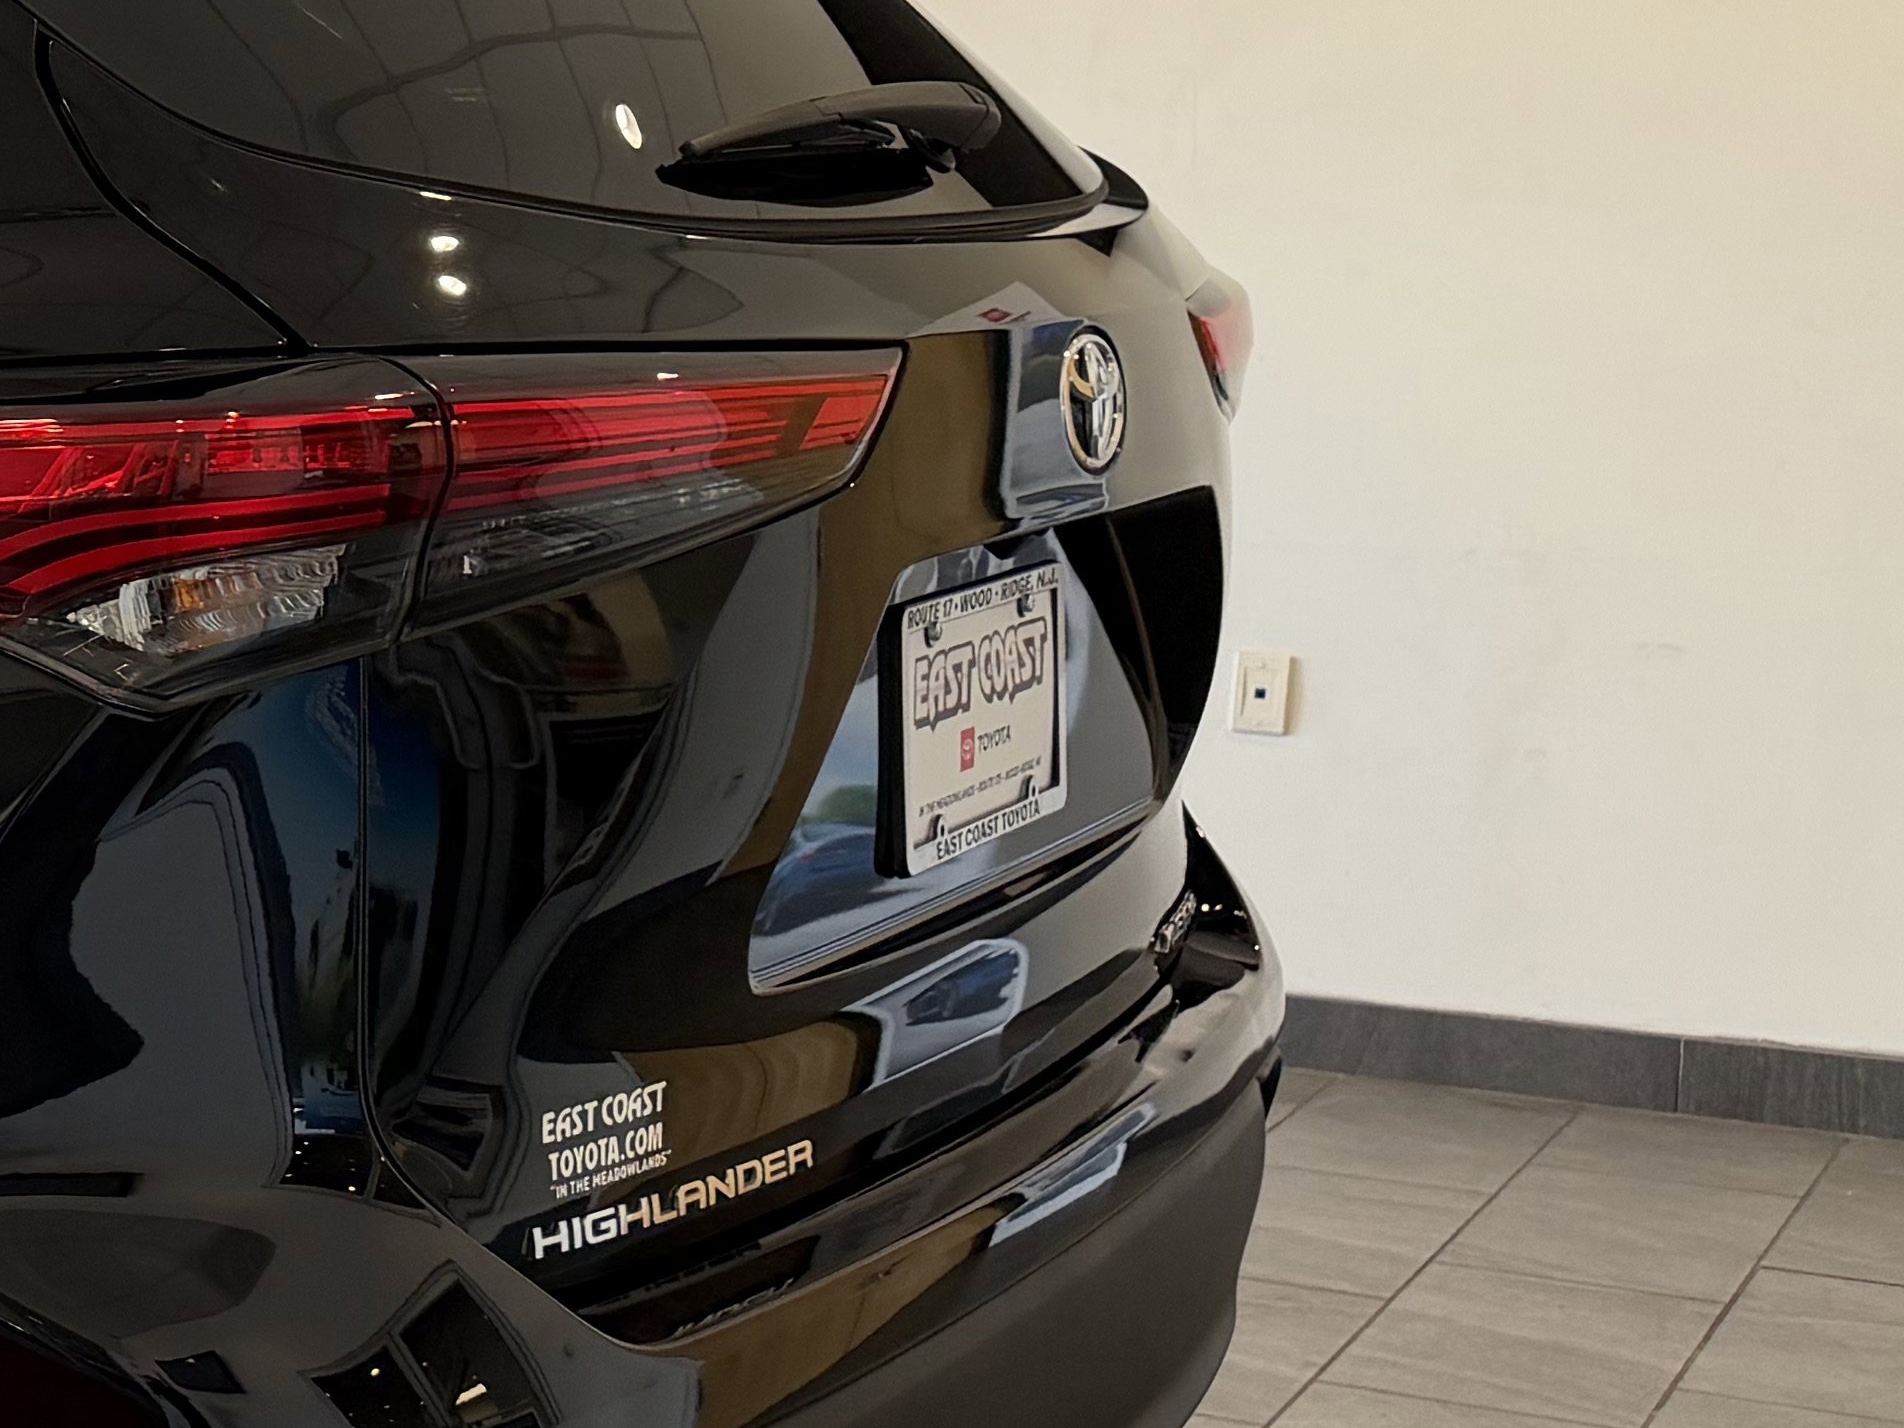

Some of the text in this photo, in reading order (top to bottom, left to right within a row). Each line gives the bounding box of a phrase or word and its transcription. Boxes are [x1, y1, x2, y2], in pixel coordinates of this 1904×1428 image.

[907, 601, 941, 630] ROUTE
[943, 597, 954, 618] 17
[960, 588, 992, 613] WOOD
[1036, 568, 1059, 589] N.J.
[914, 616, 1048, 732] EAST COAST
[977, 724, 1011, 755] TOYOTA
[936, 798, 1041, 860] EAST COAST TOYOTA
[542, 1080, 667, 1144] EAST COAST
[548, 1121, 663, 1181] TOYOTA.COM
[531, 1139, 814, 1260] HIGHLANDER
[570, 1176, 591, 1194] THE
